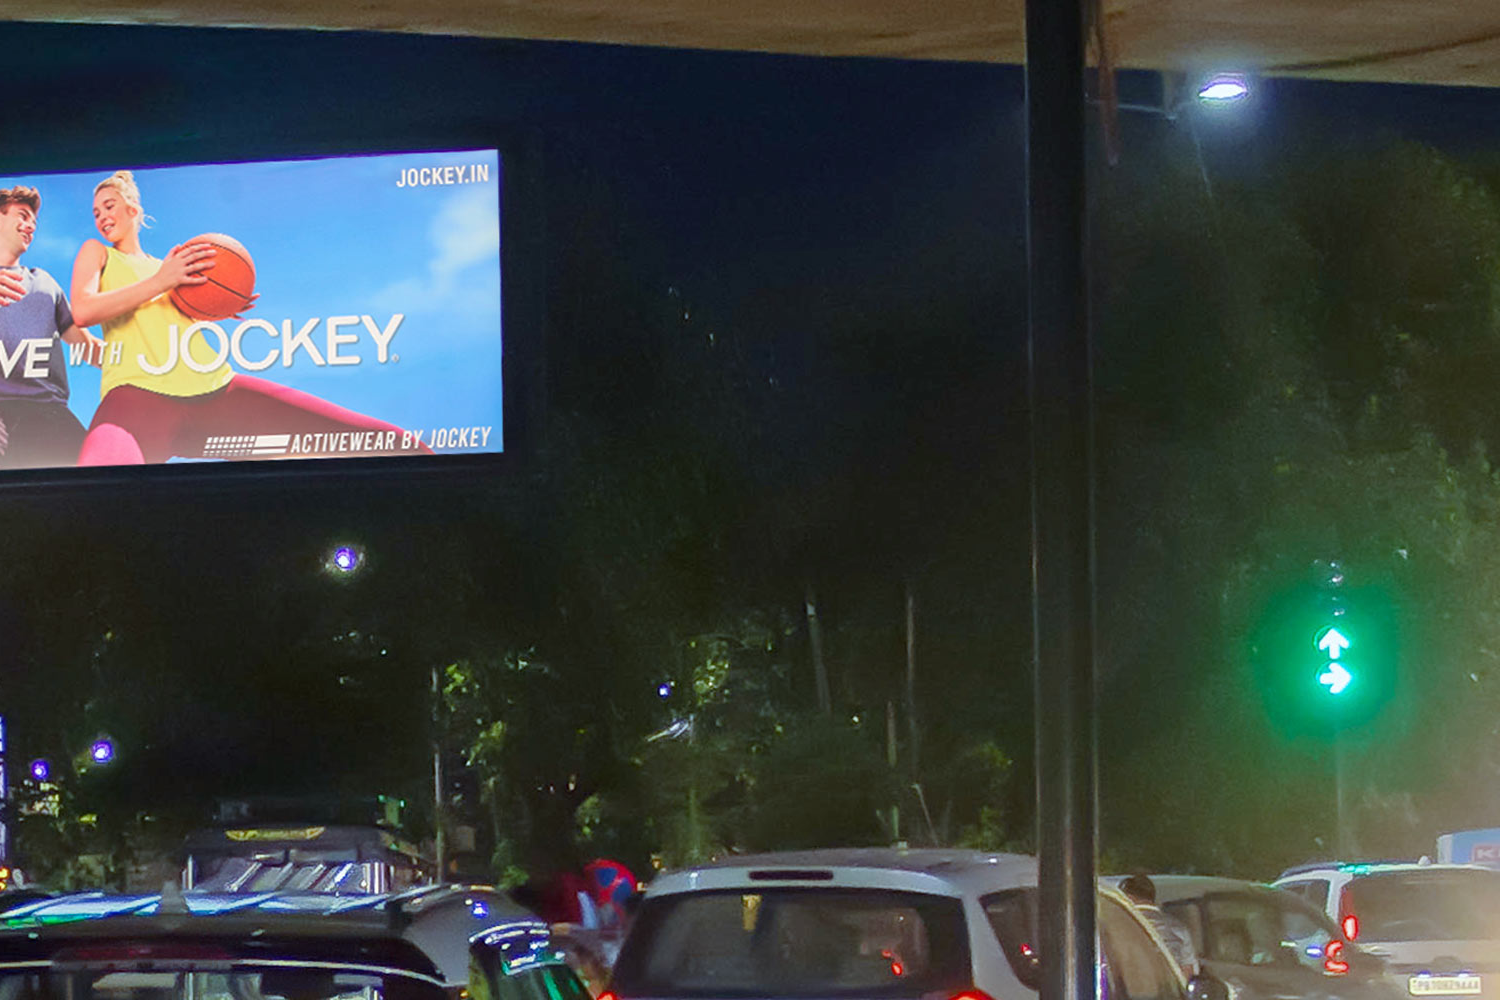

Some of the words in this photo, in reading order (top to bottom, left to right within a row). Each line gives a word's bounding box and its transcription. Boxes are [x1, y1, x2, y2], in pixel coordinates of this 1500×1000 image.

[395, 165, 490, 188] JOCKEY.IN
[68, 341, 123, 368] WITH
[136, 314, 405, 375] JOCKEY
[290, 432, 396, 454] ACTIVEWEAR
[401, 431, 422, 450] BY
[427, 427, 491, 449] JOCKEY
